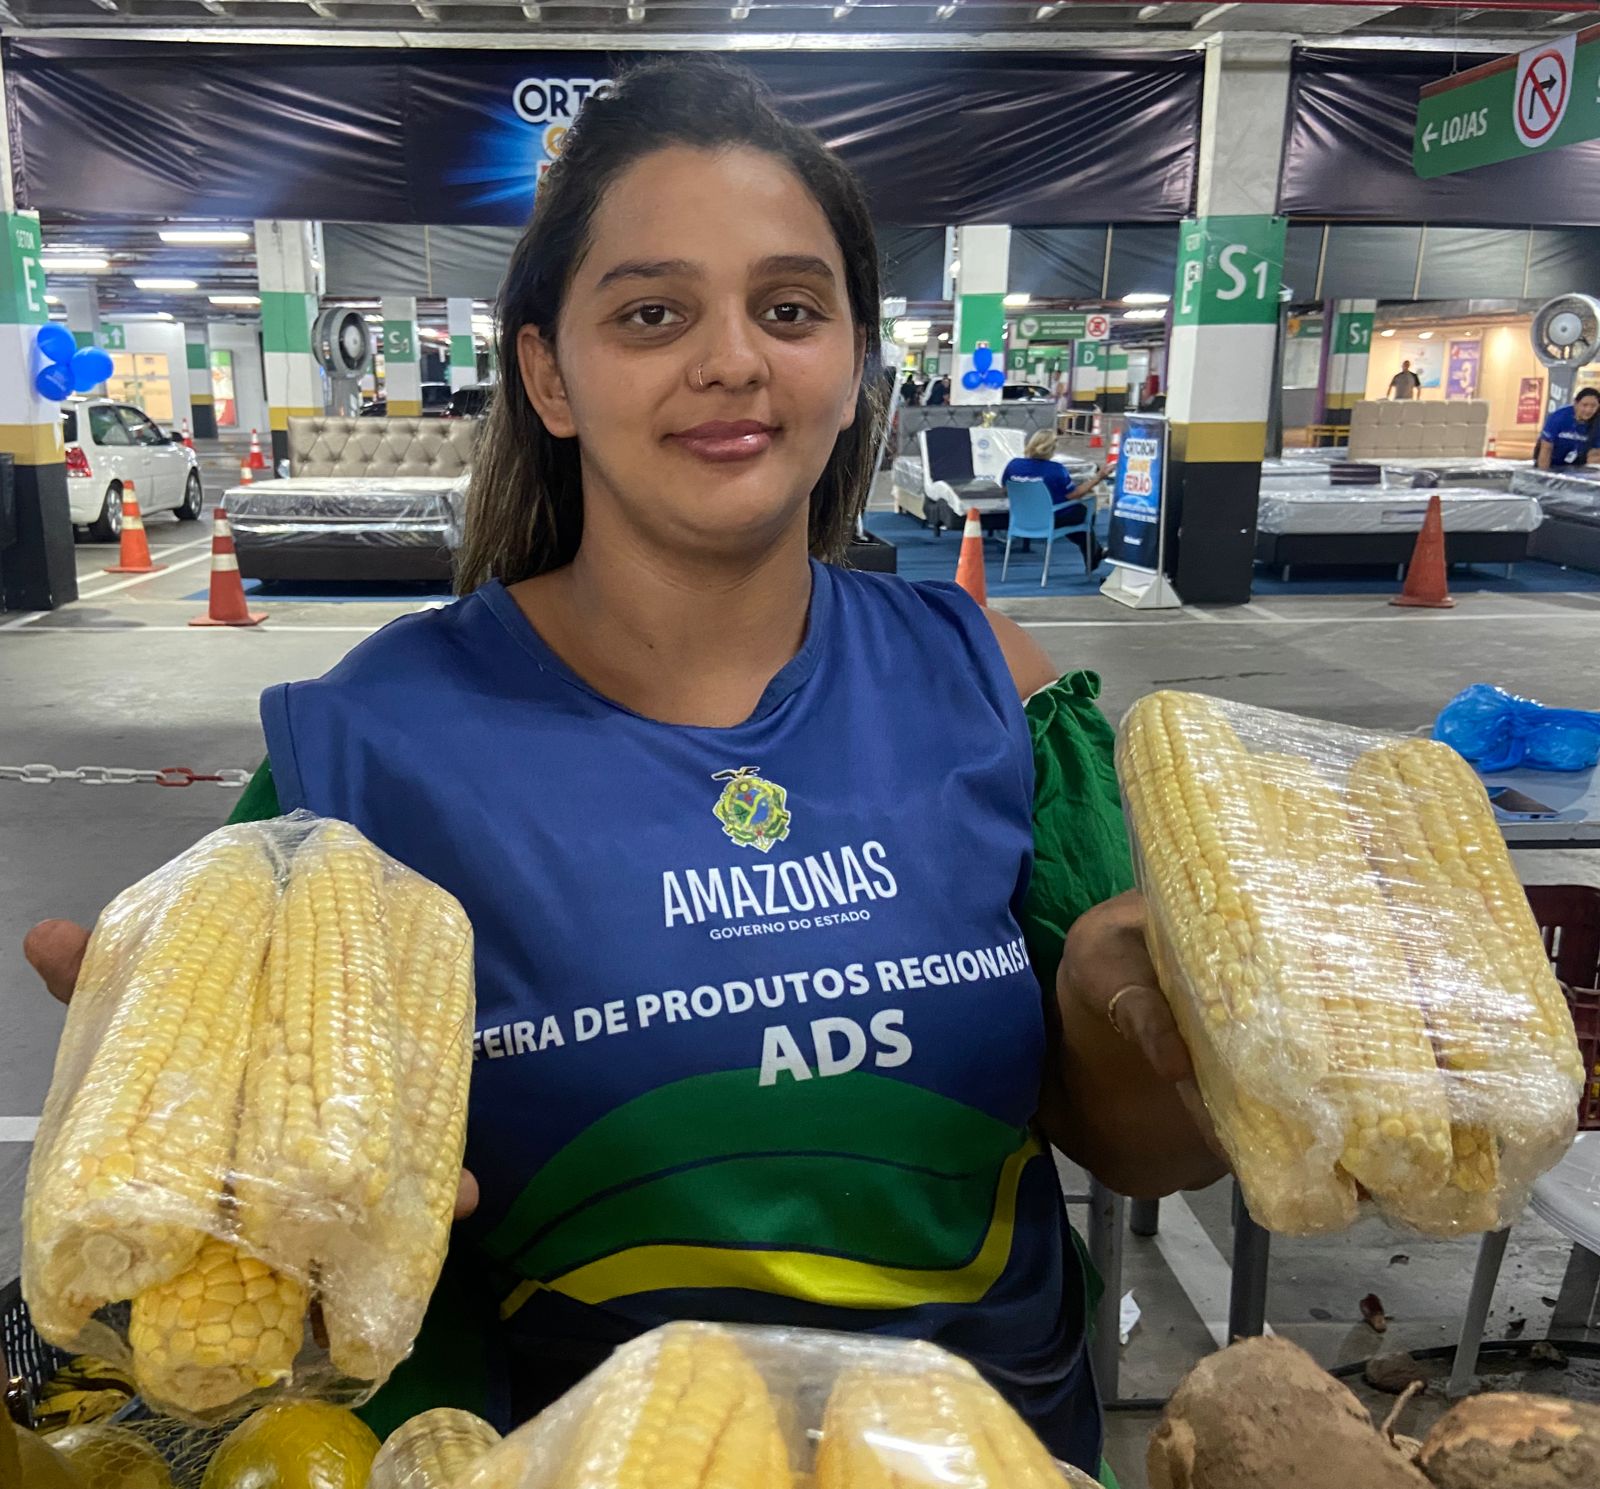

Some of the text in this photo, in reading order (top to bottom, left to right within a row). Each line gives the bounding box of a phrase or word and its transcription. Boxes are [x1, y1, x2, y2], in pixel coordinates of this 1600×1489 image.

[515, 80, 615, 120] ORT
[1440, 107, 1489, 146] LOJAS
[22, 256, 41, 312] E
[1350, 322, 1369, 345] S1
[1014, 356, 1025, 369] D
[1084, 350, 1095, 364] D
[663, 840, 898, 928] AMAZONAS
[709, 909, 871, 940] GOVERNO DO ESTADO
[473, 1015, 565, 1060] FEIRA
[573, 998, 628, 1042] DE
[636, 964, 870, 1028] PRODUTOS
[875, 940, 1025, 992] REGIONAIS
[758, 1009, 913, 1087] ADS
